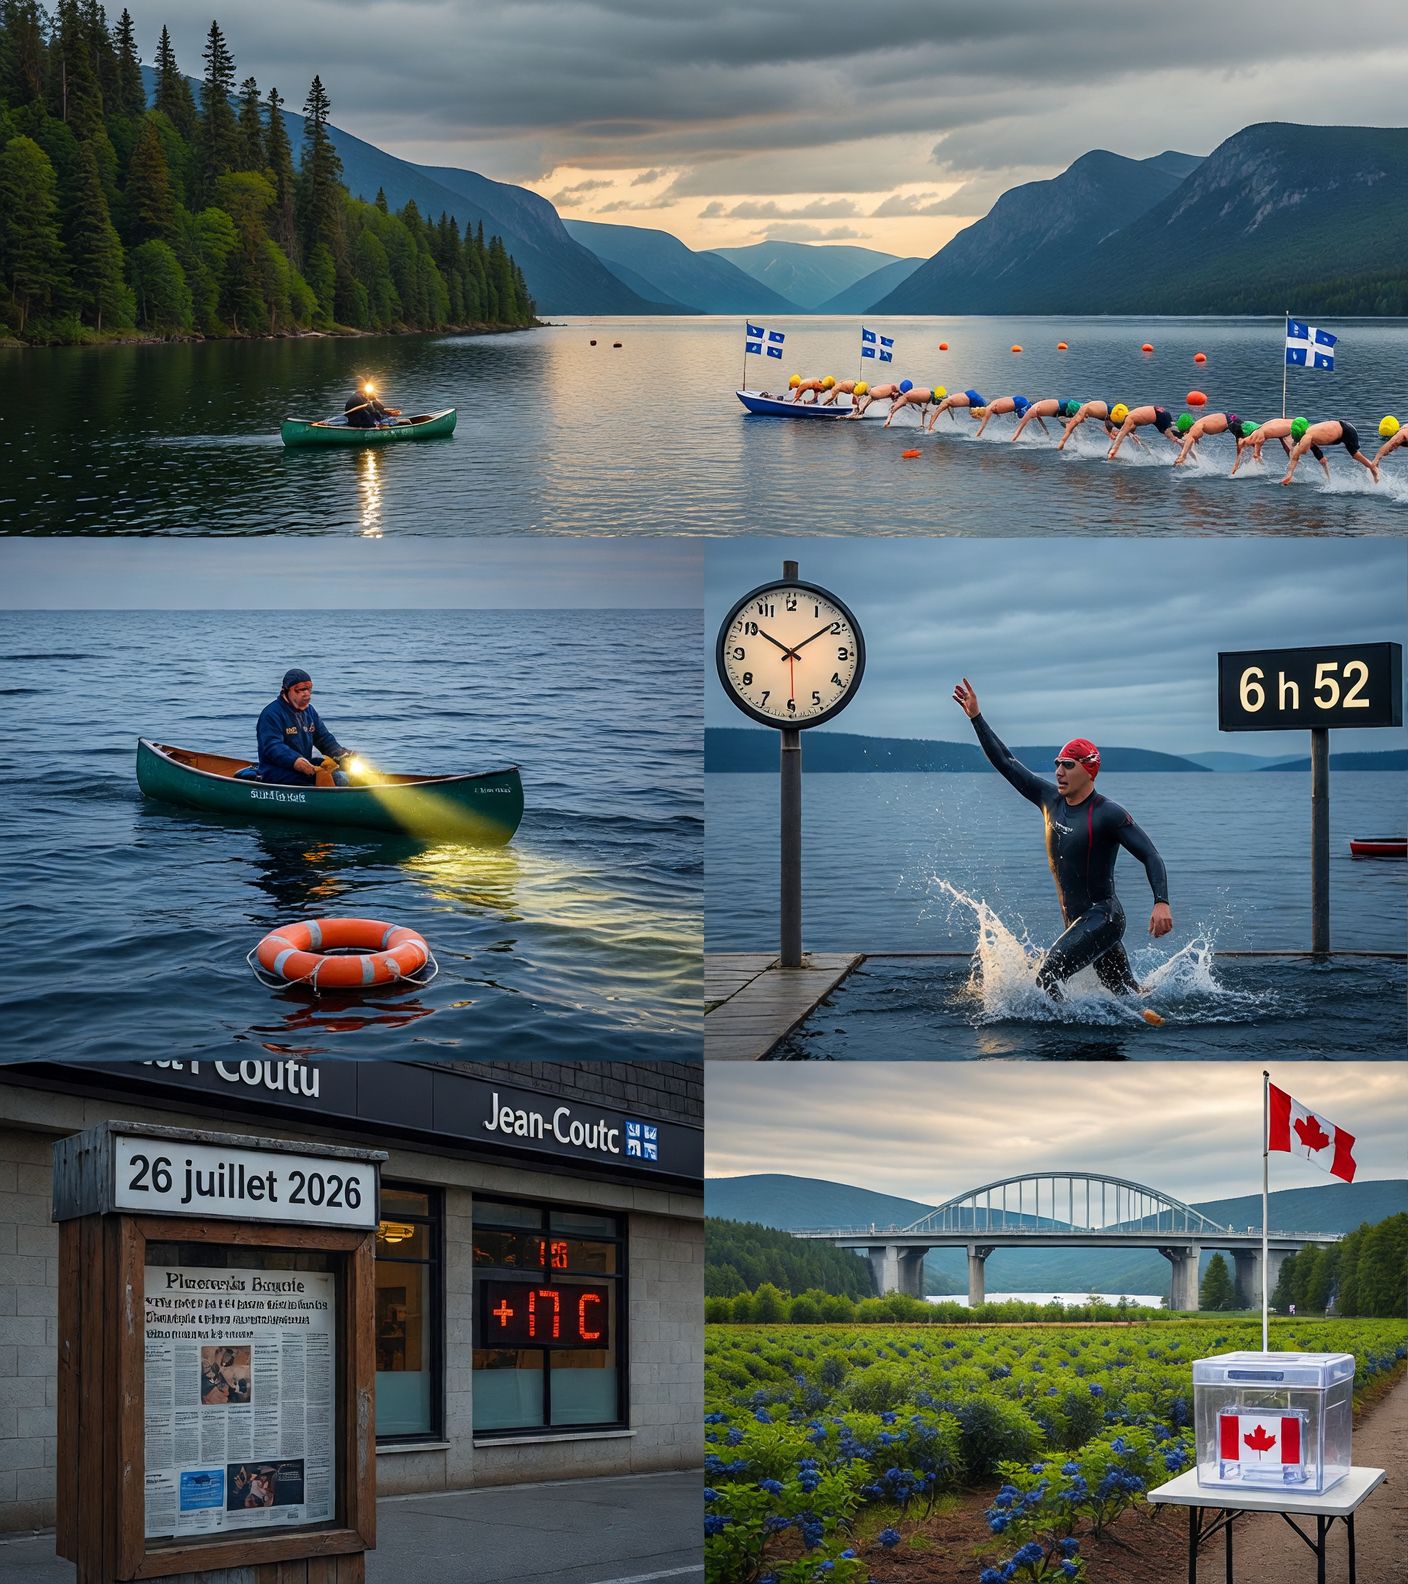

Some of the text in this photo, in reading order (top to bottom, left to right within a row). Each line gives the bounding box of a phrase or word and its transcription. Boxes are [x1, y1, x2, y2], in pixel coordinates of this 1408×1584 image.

[814, 605, 819, 618] 1
[830, 621, 841, 635] 2
[733, 647, 745, 661] 9
[837, 647, 849, 661] 3
[742, 671, 753, 686] 8
[830, 672, 846, 688] 4
[1239, 660, 1370, 713] 6 h 52
[761, 690, 771, 708] 7
[786, 698, 796, 713] 6
[811, 690, 820, 706] 5
[128, 1154, 362, 1210] 26 juillet 2026
